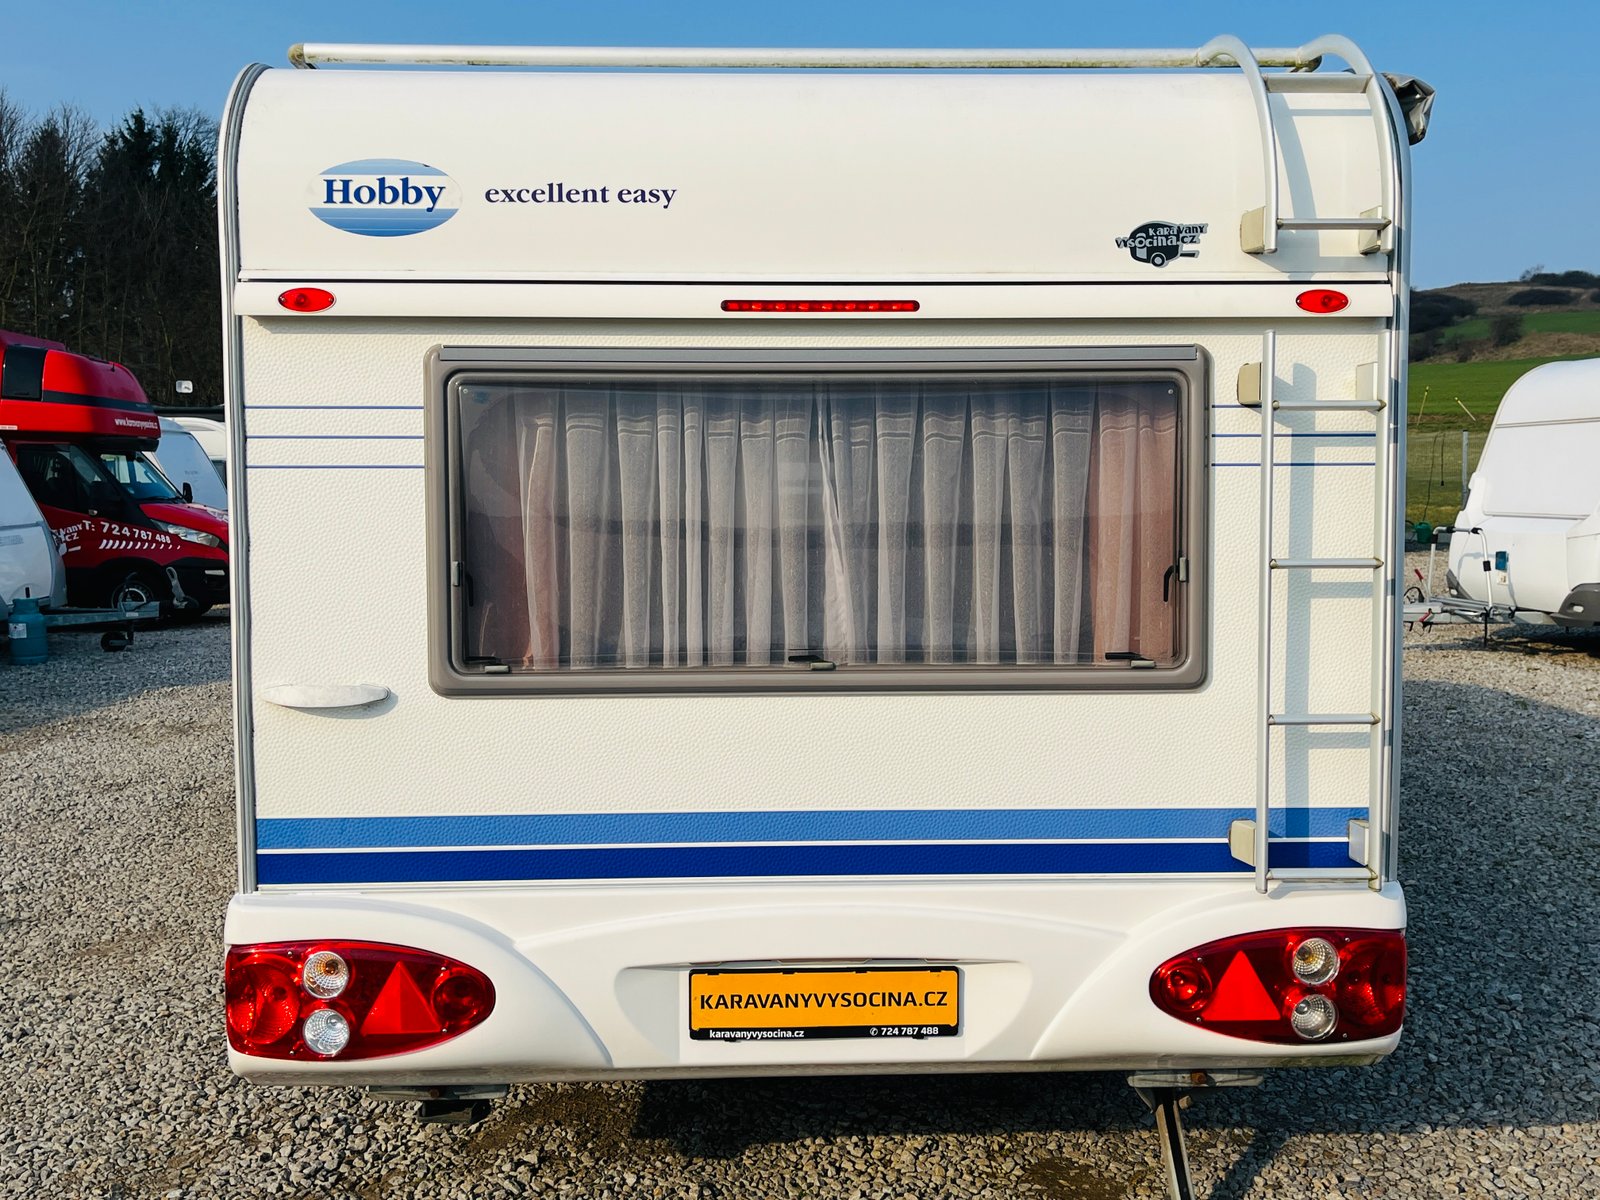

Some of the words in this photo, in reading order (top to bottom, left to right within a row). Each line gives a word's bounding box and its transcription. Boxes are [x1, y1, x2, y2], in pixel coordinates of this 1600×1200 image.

[322, 176, 446, 212] Hobby
[485, 182, 610, 204] excellent
[617, 185, 677, 209] easy
[100, 521, 130, 537] 724
[133, 528, 152, 541] 787
[155, 533, 172, 544] 488
[700, 991, 948, 1010] KARAVANYVYSOCINA.CZ
[709, 1028, 805, 1040] karavanyvysocina.cz
[881, 1027, 899, 1036] 724
[901, 1027, 918, 1036] 787
[920, 1026, 939, 1035] 488
